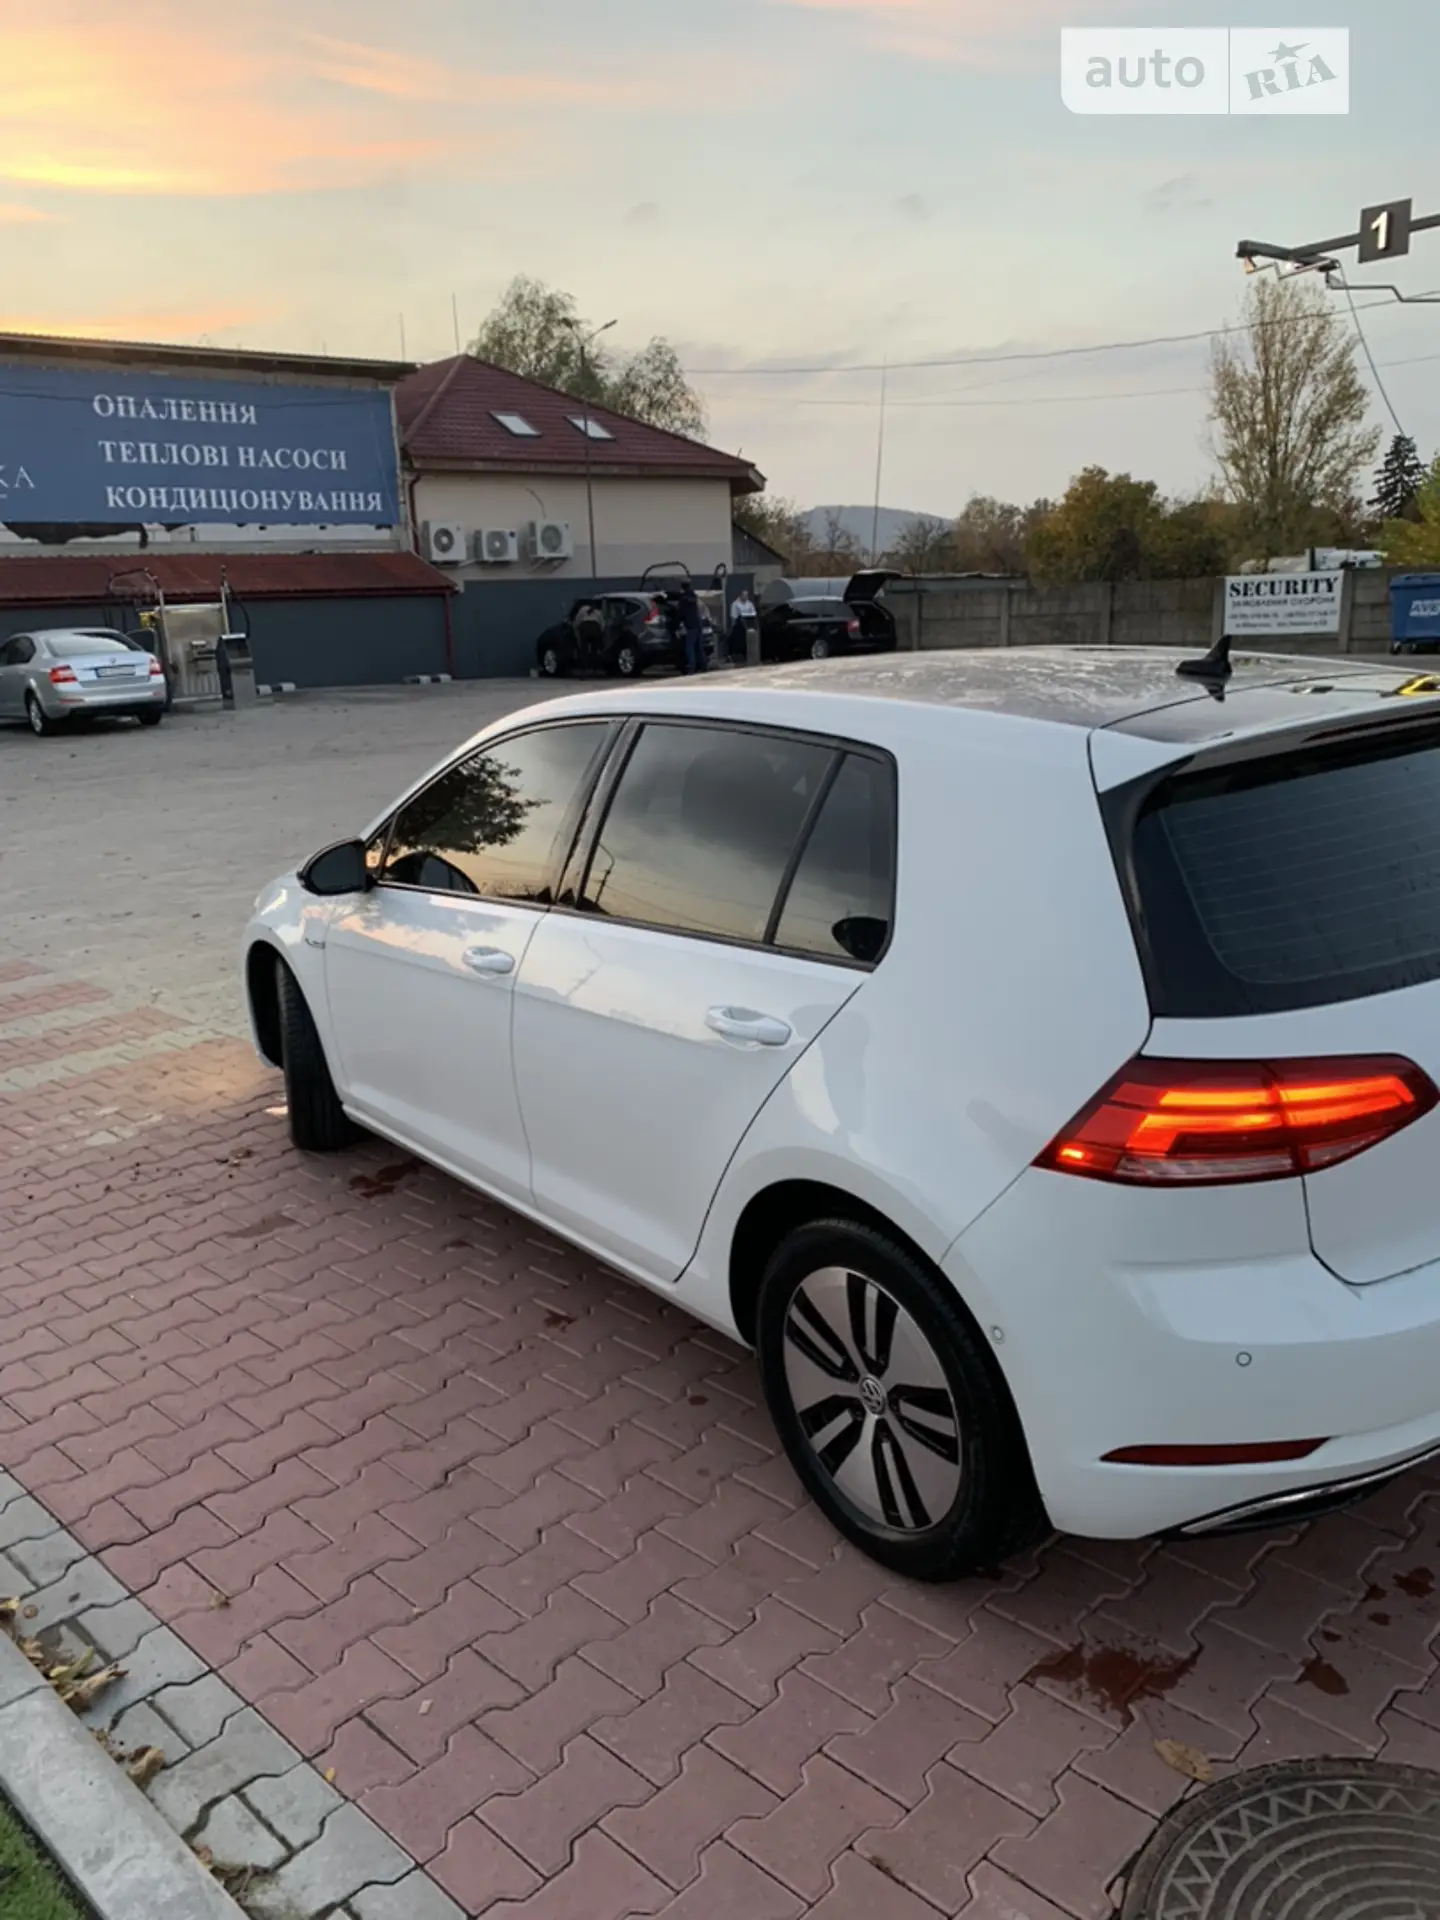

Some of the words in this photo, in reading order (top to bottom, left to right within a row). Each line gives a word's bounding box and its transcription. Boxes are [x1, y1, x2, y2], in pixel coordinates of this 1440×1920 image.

[1370, 210, 1388, 250] 1
[93, 394, 257, 424] ОПАЛЕННЯ
[99, 441, 229, 467] ТЕПЛОВІ
[238, 447, 347, 470] НАСОСИ
[106, 486, 383, 513] КОНДИЦІОНУВАННЯ
[1229, 577, 1338, 598] SECURITY
